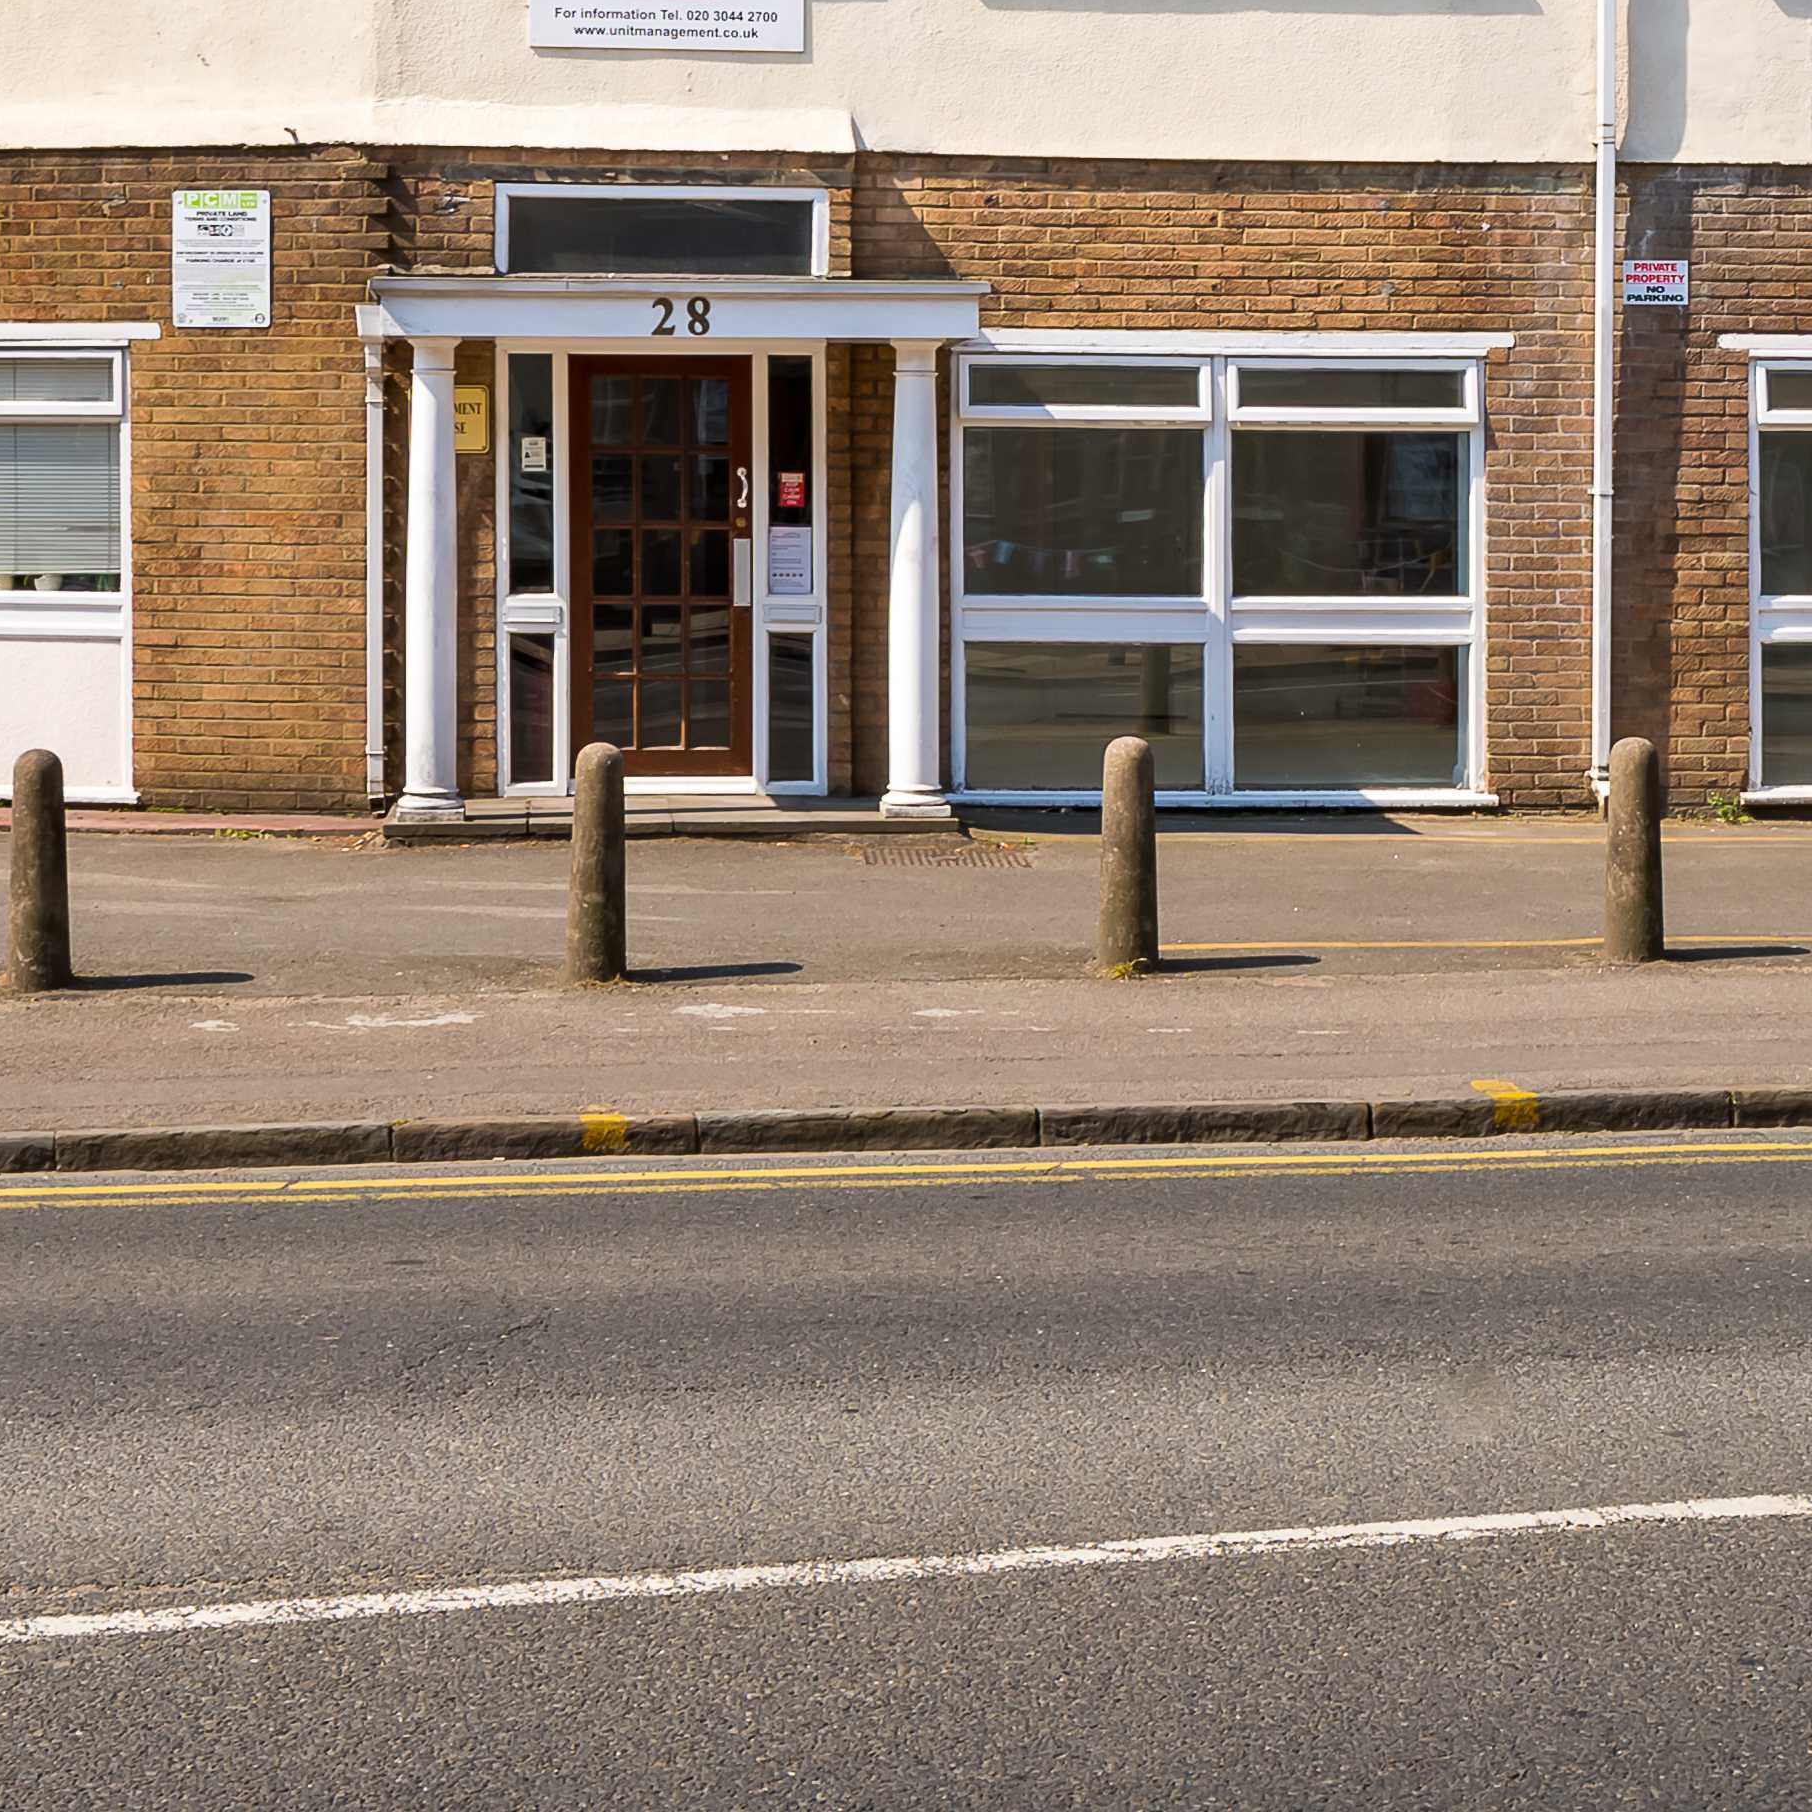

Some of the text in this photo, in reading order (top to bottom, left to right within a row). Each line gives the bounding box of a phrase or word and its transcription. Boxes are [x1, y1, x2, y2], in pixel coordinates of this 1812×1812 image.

[555, 8, 778, 22] For information Tel. 020 3044 2700
[574, 26, 758, 39] www.unitmanagement.co.uk
[185, 193, 238, 208] PCM
[1634, 263, 1677, 271] PRIVATE
[1626, 275, 1684, 283] PROPERTY
[652, 297, 710, 335] 28
